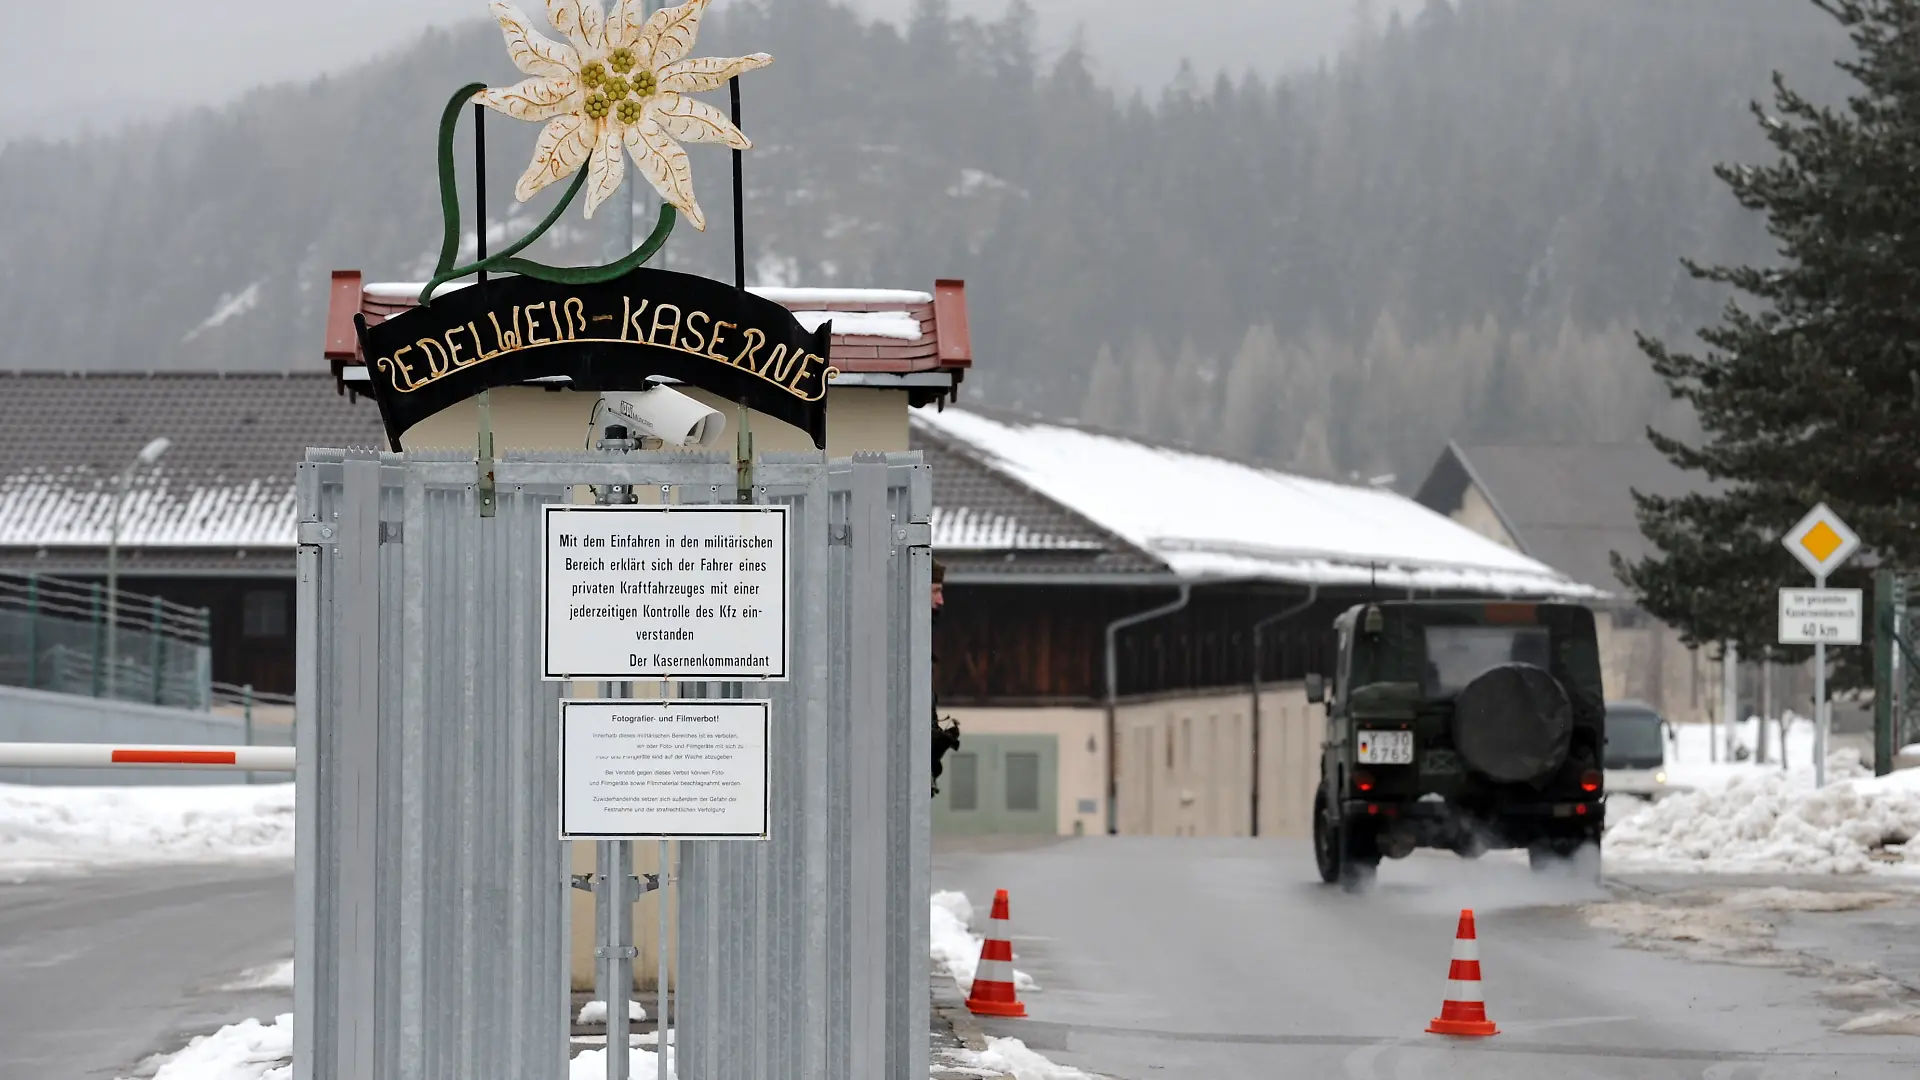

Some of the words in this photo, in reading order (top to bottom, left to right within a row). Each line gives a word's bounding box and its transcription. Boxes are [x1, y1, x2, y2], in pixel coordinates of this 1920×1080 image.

[559, 534, 577, 548] Mit
[583, 534, 605, 548] dem
[611, 534, 660, 548] Einfahren
[666, 534, 675, 548] in
[680, 534, 699, 548] den
[704, 534, 773, 548] militärischen
[565, 557, 605, 571] Bereich
[610, 558, 645, 571] erklärt
[651, 558, 673, 571] sich
[678, 558, 695, 571] der
[700, 558, 733, 571] Fahrer
[739, 558, 767, 571] eines
[572, 581, 615, 596] privaten
[620, 581, 705, 598] Kraftfahrzeuges
[710, 581, 728, 594] mit
[733, 581, 760, 594] einer
[569, 604, 638, 621] jederzeitigen
[643, 604, 690, 618] Kontrolle
[695, 604, 714, 618] des
[719, 605, 737, 618] Kfz
[742, 604, 763, 618] ein-
[635, 627, 694, 641] verstanden
[1802, 622, 1816, 637] 40
[1819, 623, 1838, 637] km
[629, 653, 647, 667] Der
[653, 653, 770, 667] Kasernenkommandant
[612, 714, 656, 724] Fotografier-
[658, 714, 674, 723] und
[676, 714, 720, 723] Filmverbot!
